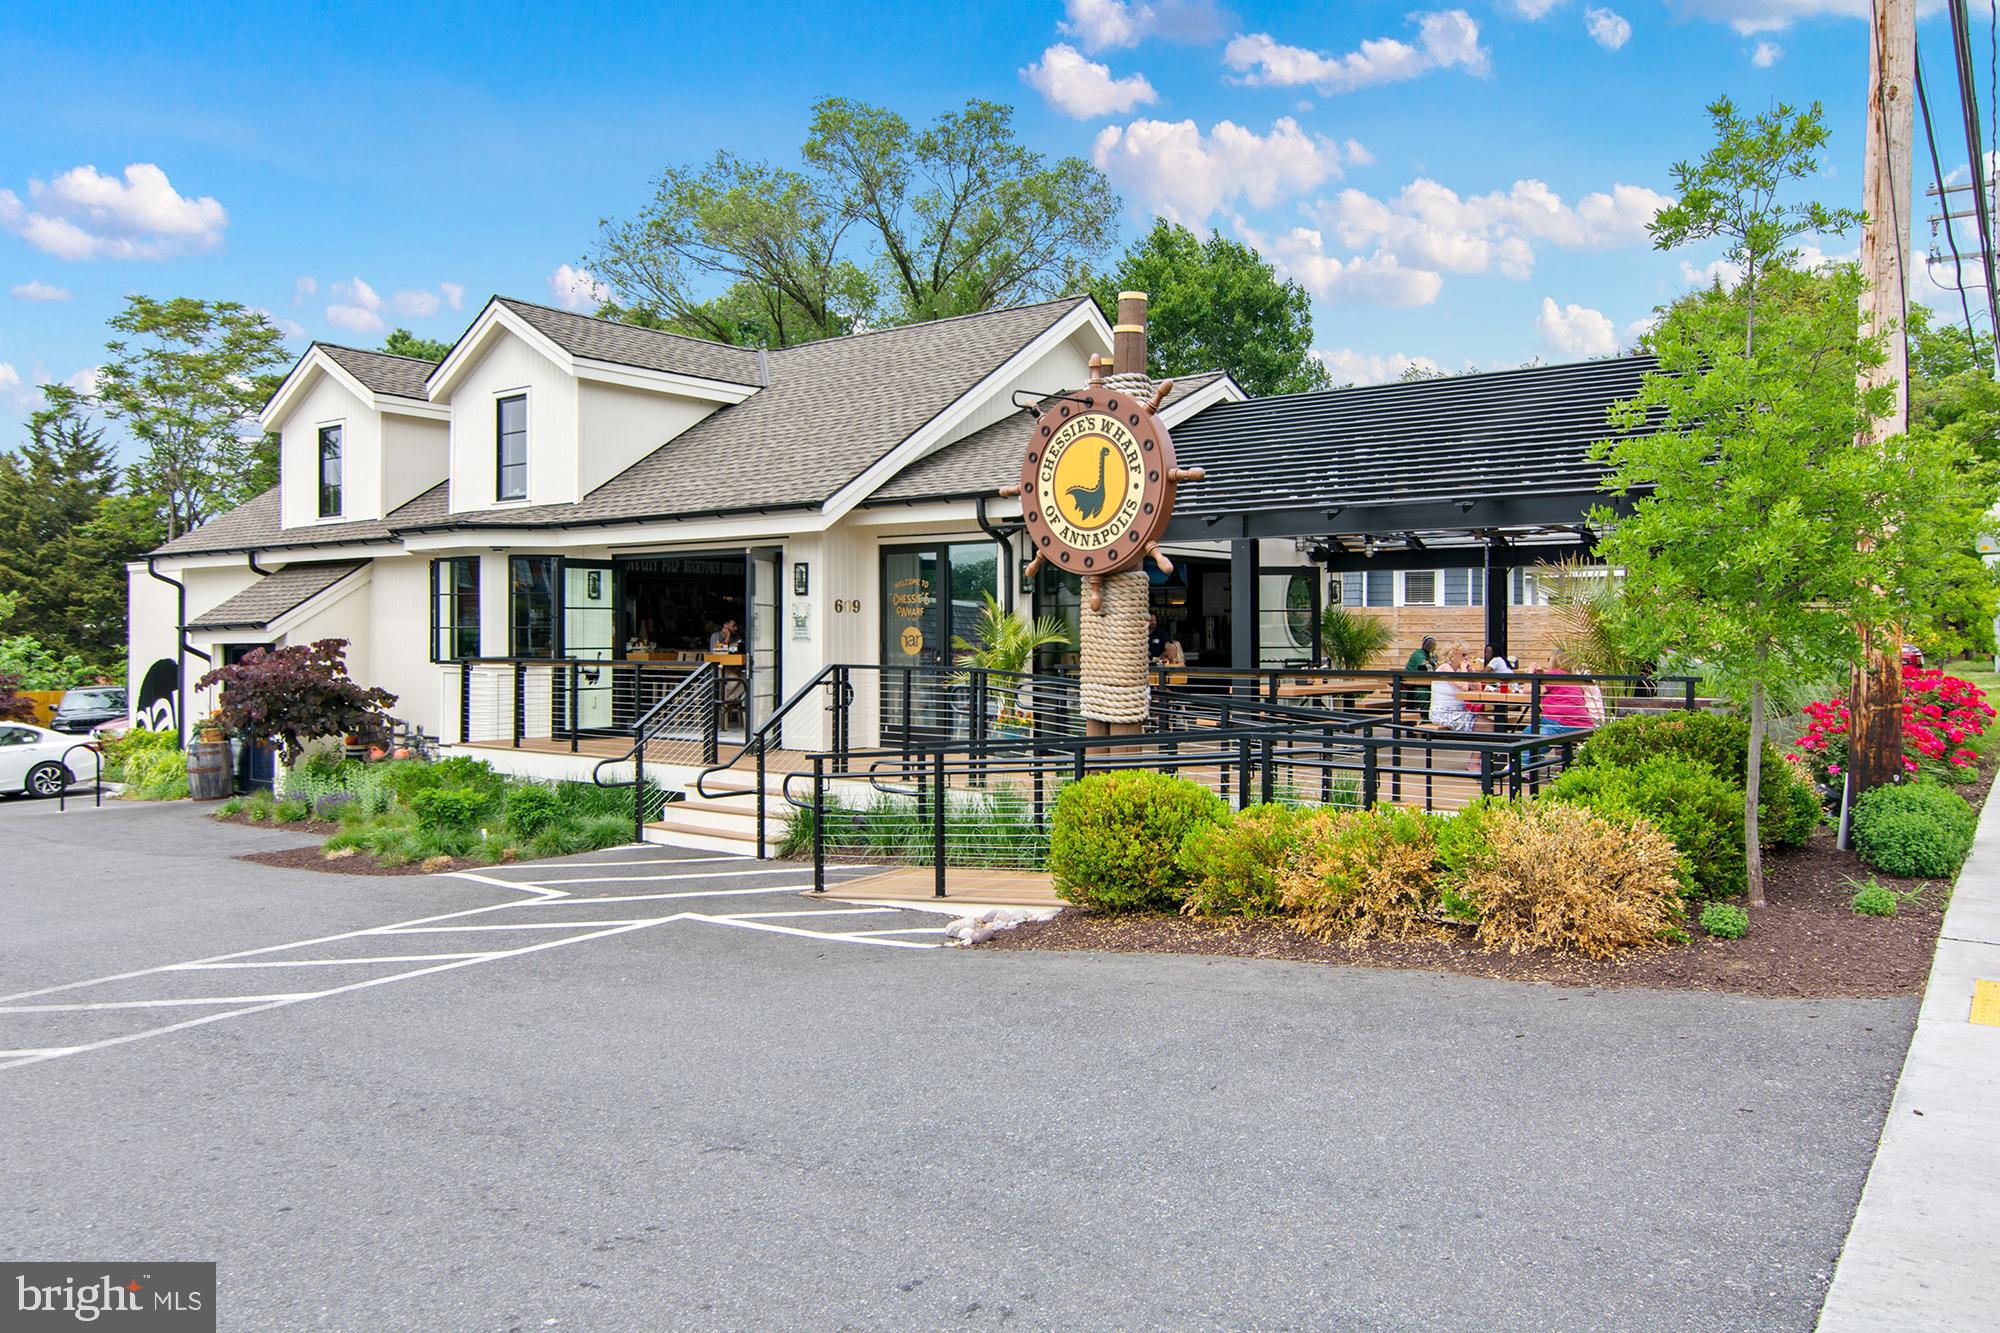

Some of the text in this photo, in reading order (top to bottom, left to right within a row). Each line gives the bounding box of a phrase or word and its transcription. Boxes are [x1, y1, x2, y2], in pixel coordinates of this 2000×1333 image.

[1041, 416, 1142, 482] CHESSIE'S WHARF
[1045, 499, 1138, 547] OF ANNAPOLIS
[895, 578, 930, 590] WELCOME TO
[834, 599, 861, 614] 609
